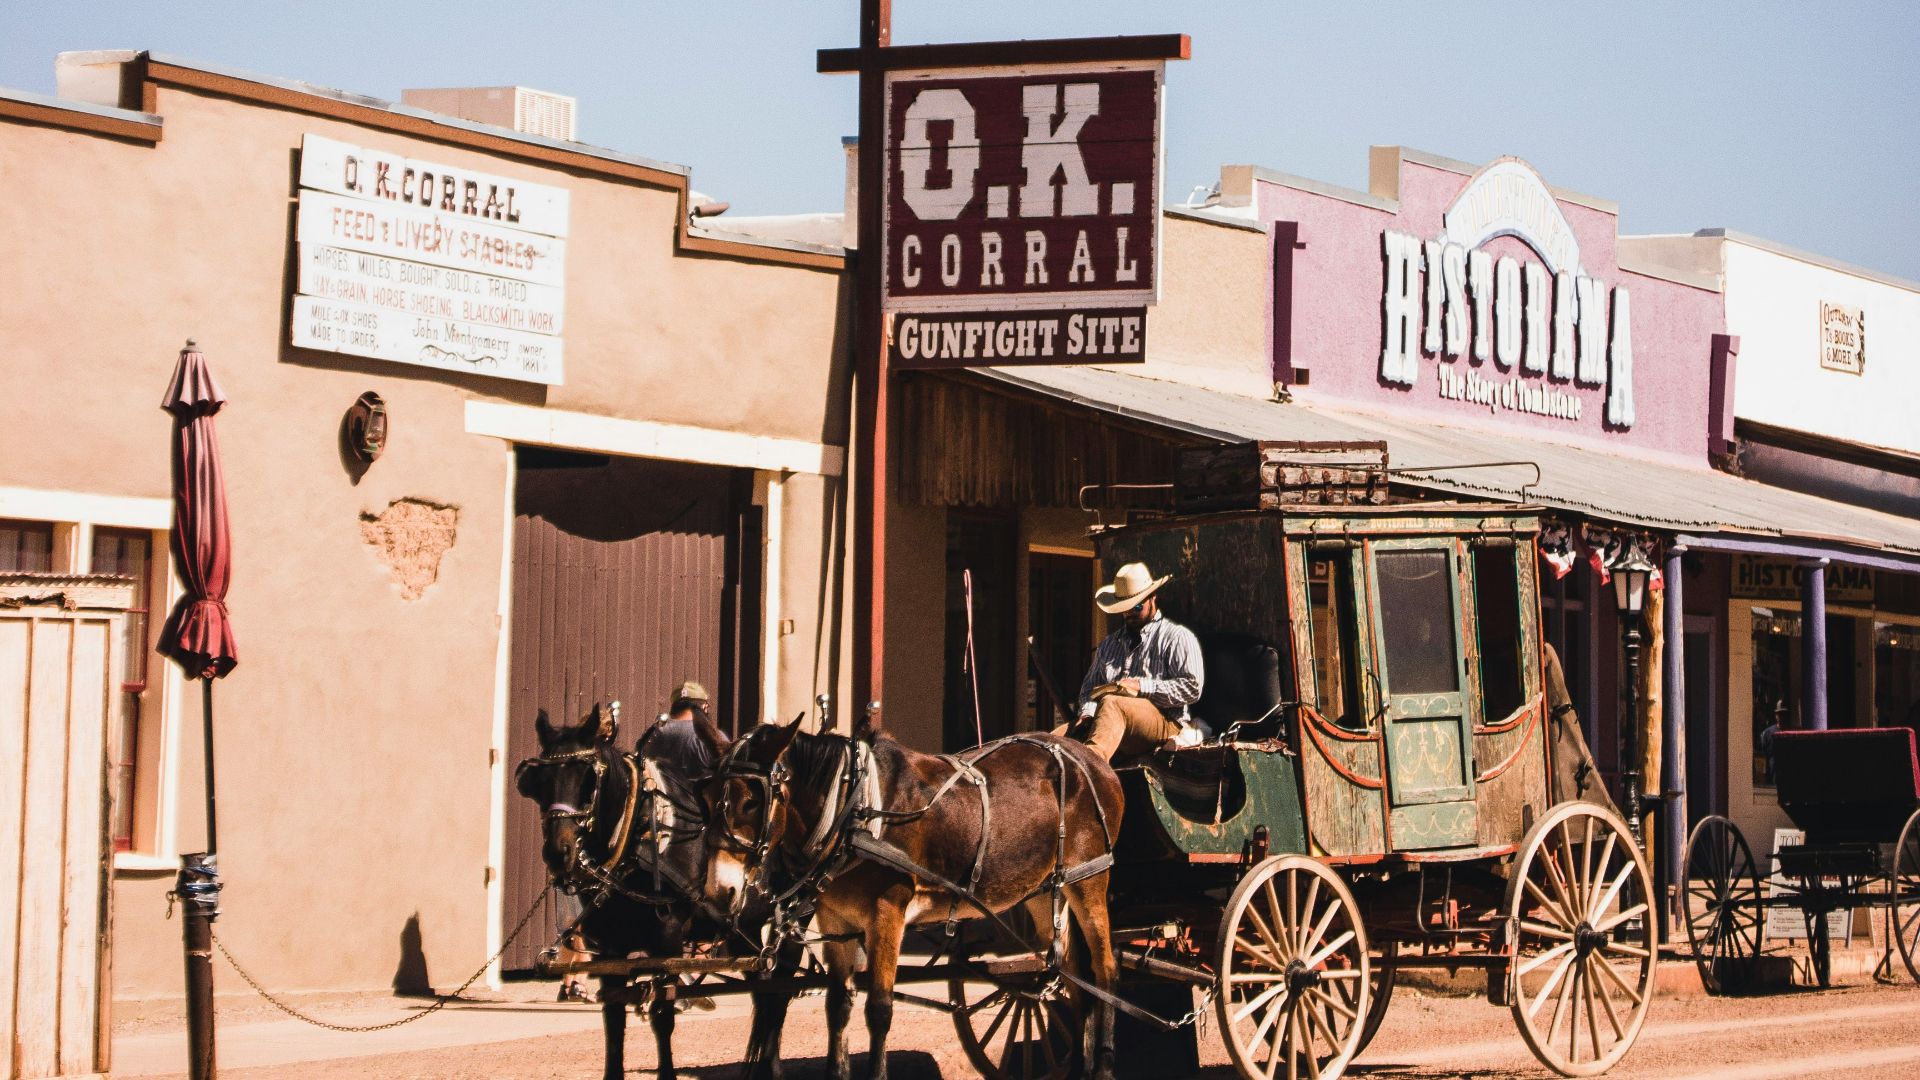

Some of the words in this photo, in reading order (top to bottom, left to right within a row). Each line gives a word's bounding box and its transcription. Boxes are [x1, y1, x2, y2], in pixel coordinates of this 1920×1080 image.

[900, 82, 1137, 221] O.K.
[333, 205, 376, 242] FEED
[395, 215, 453, 256] LIVERY
[460, 230, 536, 271] STABLES
[902, 226, 1138, 288] CORRAL
[313, 273, 330, 295] HAY
[372, 287, 406, 310] HORSE
[463, 300, 524, 329] BLACKSMITH
[529, 309, 555, 331] WORK
[488, 277, 527, 302] TRADED
[310, 324, 332, 342] MADE
[336, 328, 346, 344] TO
[311, 304, 332, 322] MULE
[352, 311, 378, 330] SHOES
[1066, 313, 1141, 355] SITE
[1382, 229, 1636, 427] HISTORAMA
[412, 318, 438, 341] John
[444, 322, 510, 360] Montgomery
[1832, 348, 1852, 365] MORE
[1438, 362, 1465, 400] The
[1466, 368, 1501, 413] Story
[1502, 379, 1517, 410] of
[1516, 379, 1582, 420] Tombstone
[1319, 518, 1337, 529] OLD
[1739, 563, 1871, 589] HISTOAMA
